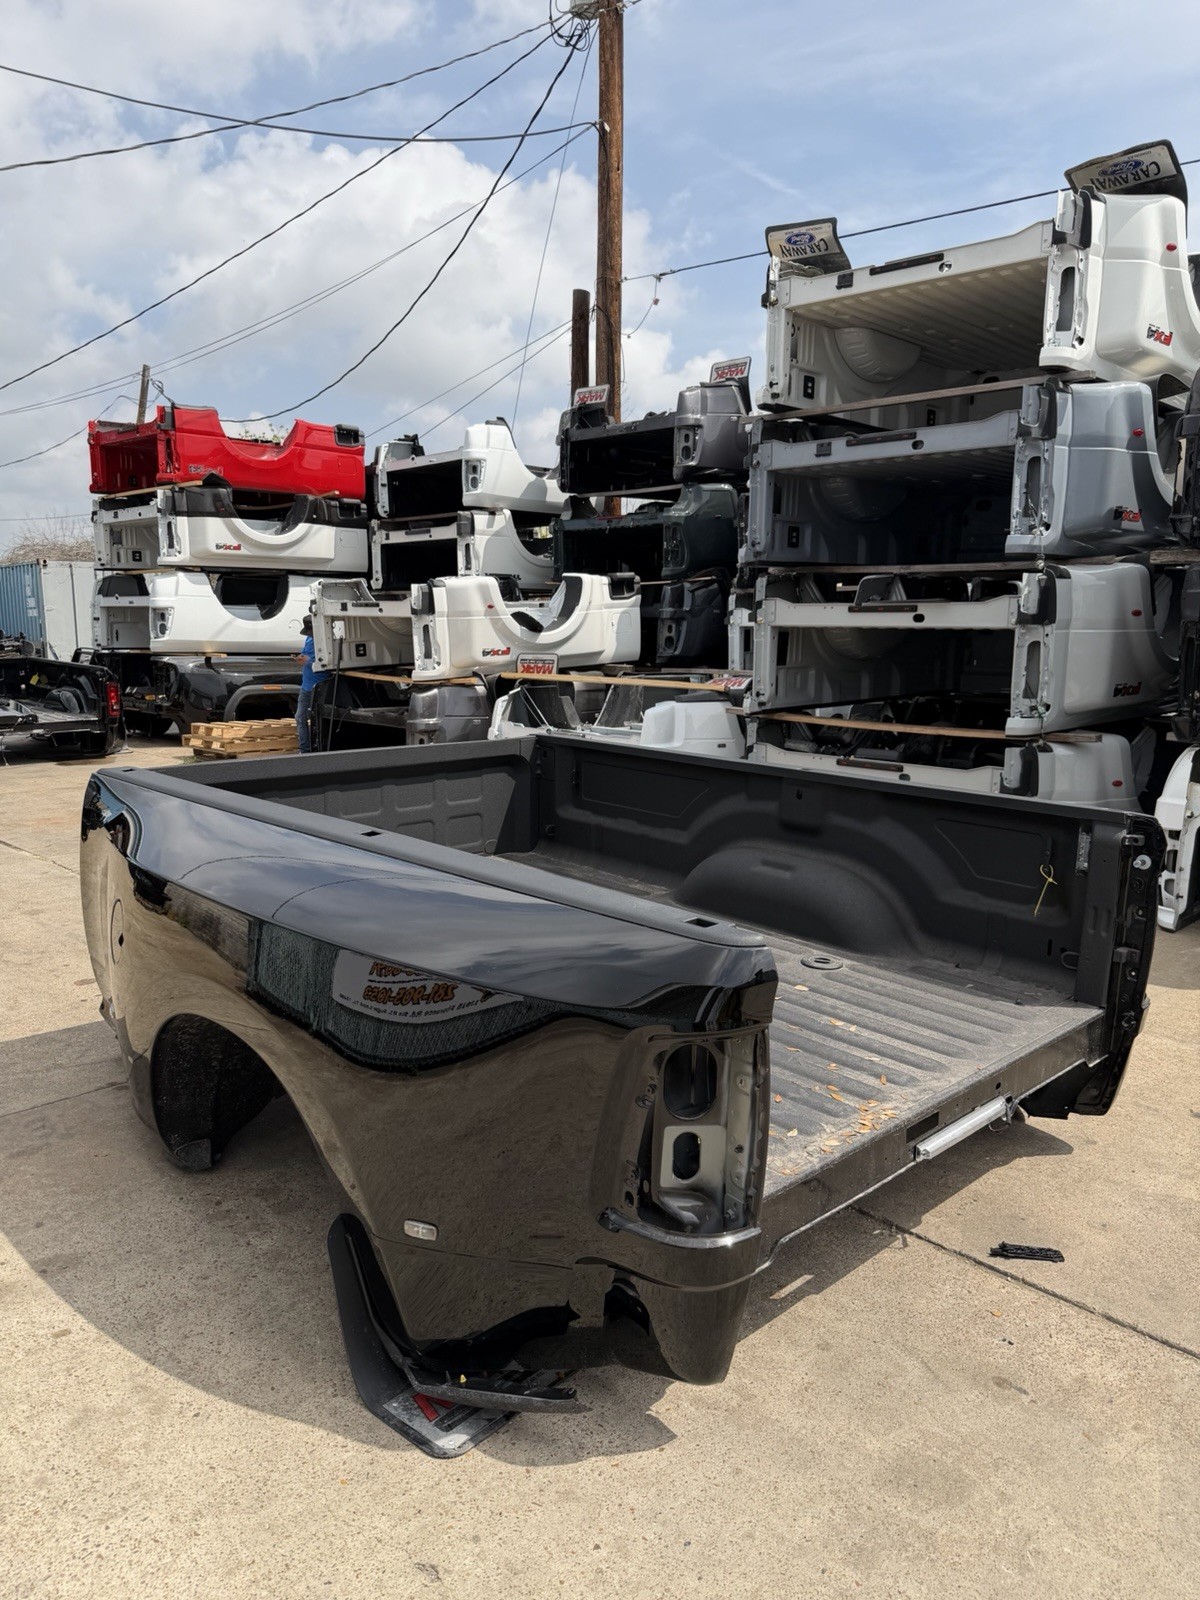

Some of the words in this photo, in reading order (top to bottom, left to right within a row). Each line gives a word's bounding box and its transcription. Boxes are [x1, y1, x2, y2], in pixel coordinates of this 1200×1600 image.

[1105, 160, 1137, 174] Ford
[1090, 161, 1161, 190] CARAWAY
[789, 233, 812, 245] Ford
[779, 238, 829, 258] CARAWAY
[1146, 326, 1174, 346] FX4
[713, 366, 747, 381] MARK
[576, 392, 605, 404] MARK
[1113, 508, 1142, 522] FX4
[482, 647, 511, 657] FX4
[520, 664, 554, 674] MARK
[1112, 682, 1142, 698] FX4
